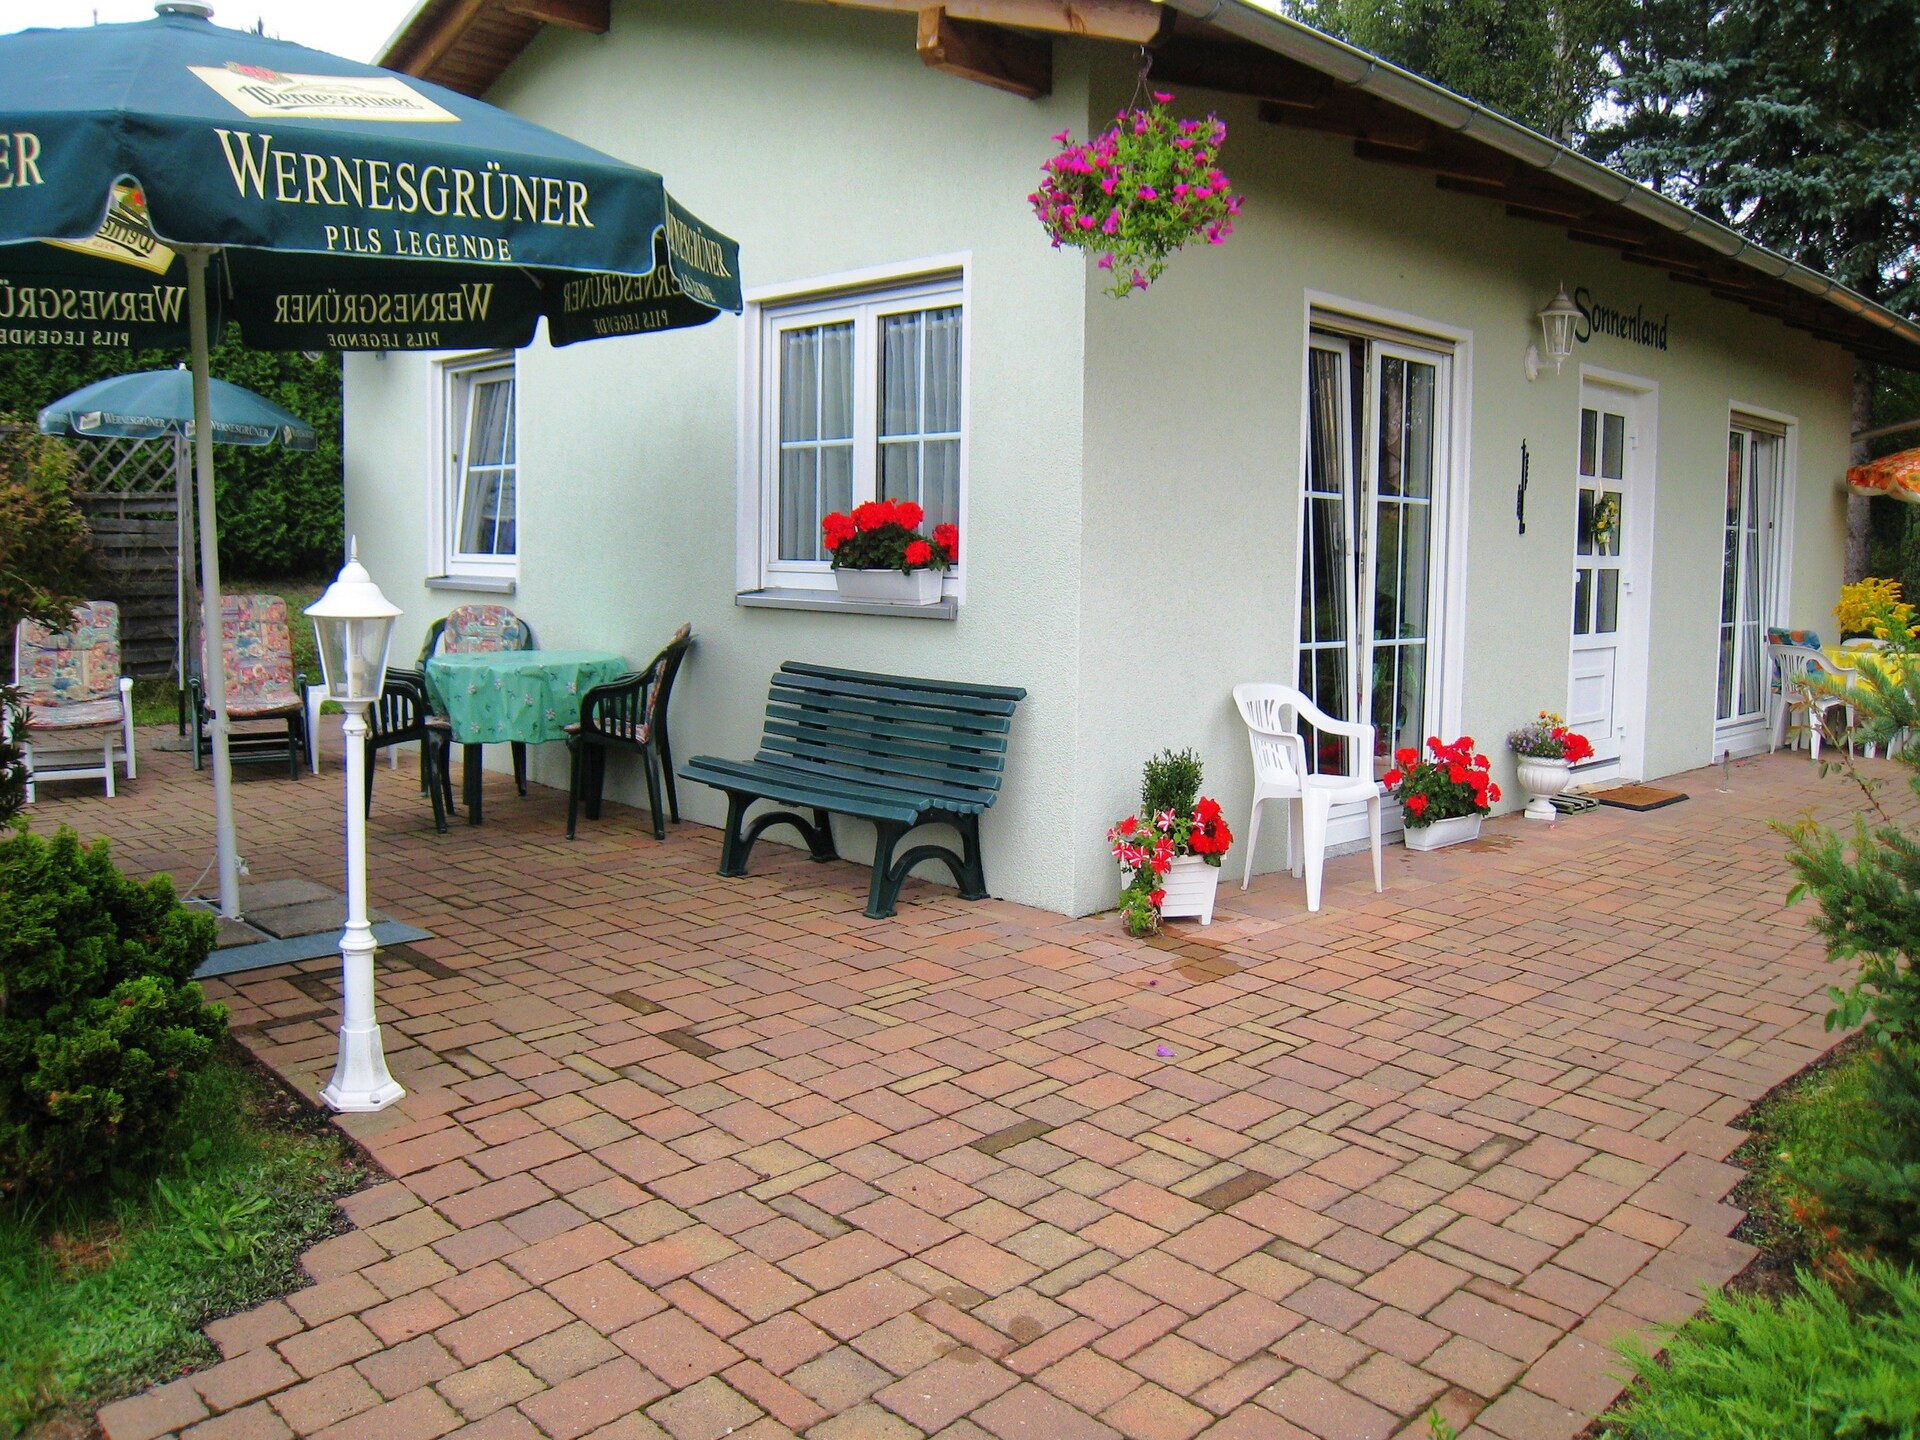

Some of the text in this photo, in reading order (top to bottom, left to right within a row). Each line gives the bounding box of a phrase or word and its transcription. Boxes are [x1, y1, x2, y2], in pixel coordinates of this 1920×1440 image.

[212, 128, 594, 228] WERNESGRÜNER
[324, 225, 512, 262] PILS LEGENDE
[1574, 286, 1669, 351] Sonnenland
